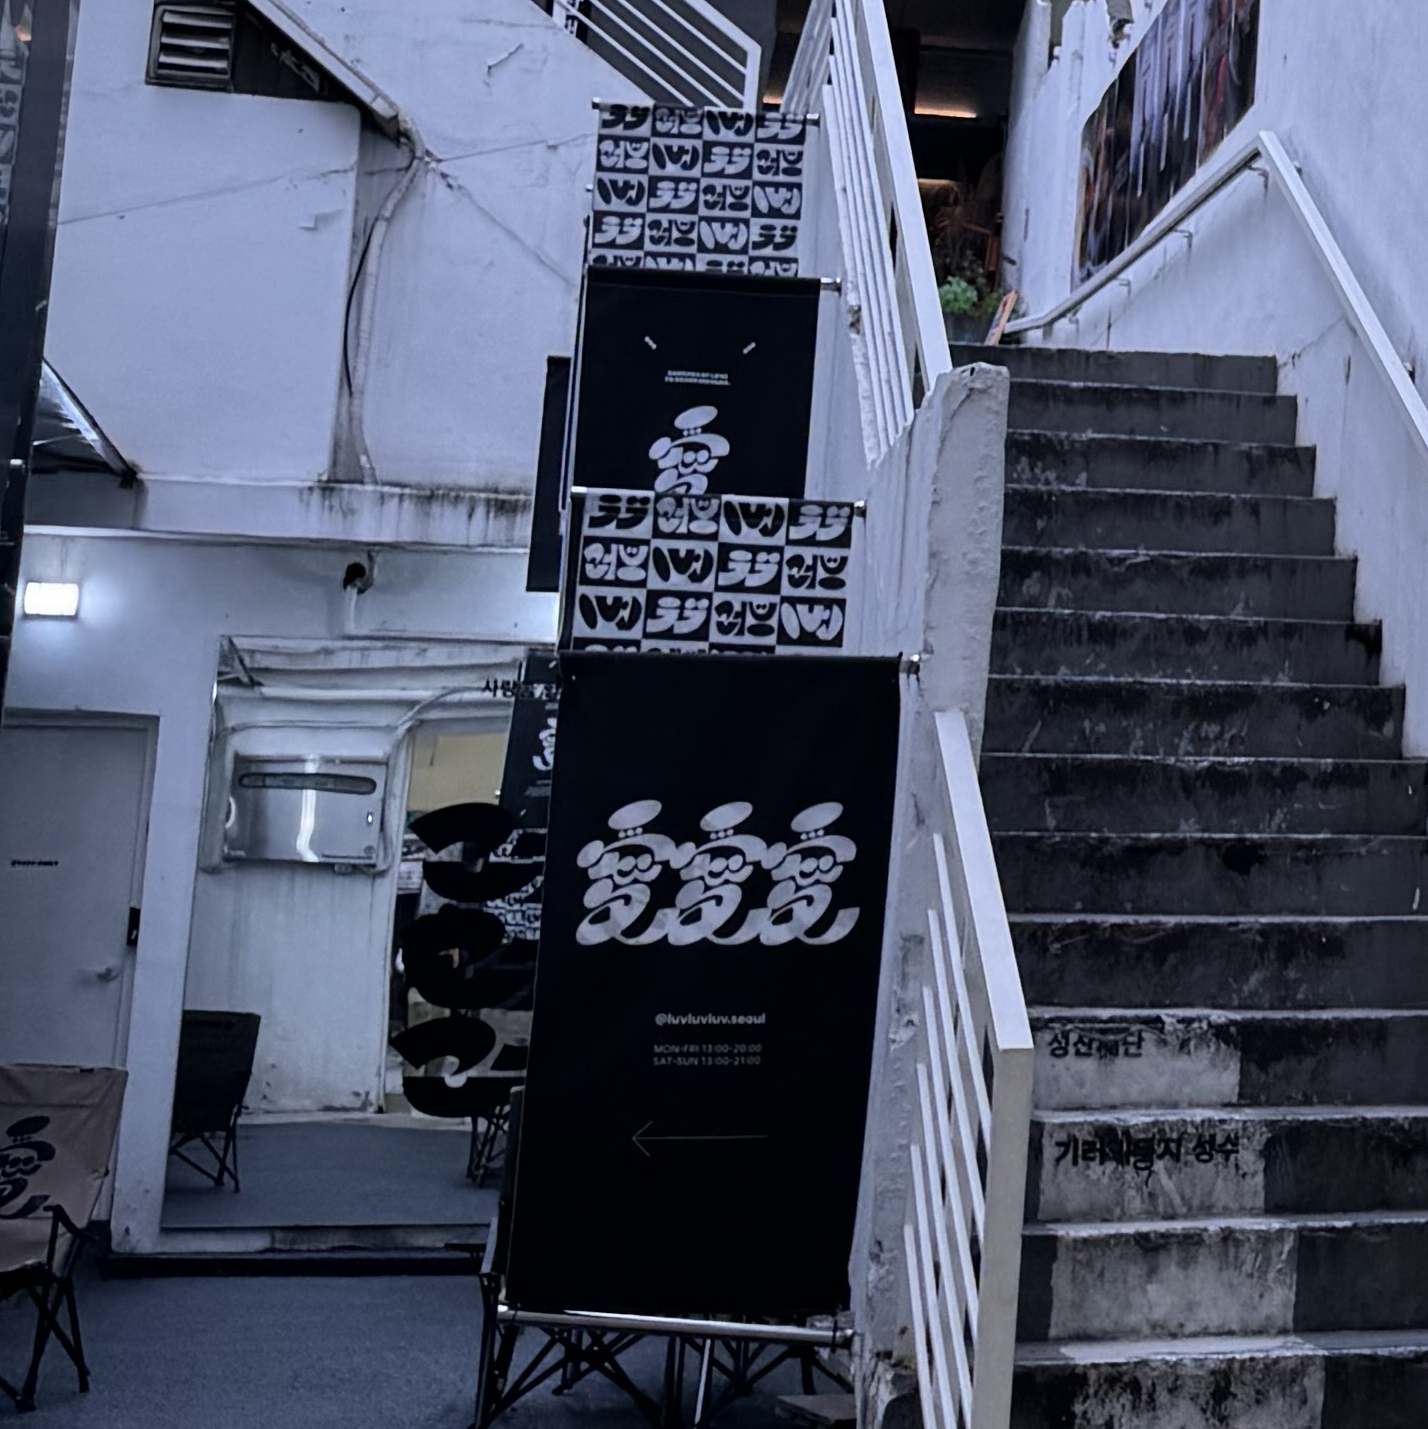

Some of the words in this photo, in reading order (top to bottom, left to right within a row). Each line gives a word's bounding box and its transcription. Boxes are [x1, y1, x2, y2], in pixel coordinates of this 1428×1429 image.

[655, 1012, 766, 1026] @luvluvluv.seoul
[653, 1044, 699, 1054] MON-FRI
[653, 1056, 699, 1066] SAT-SUN
